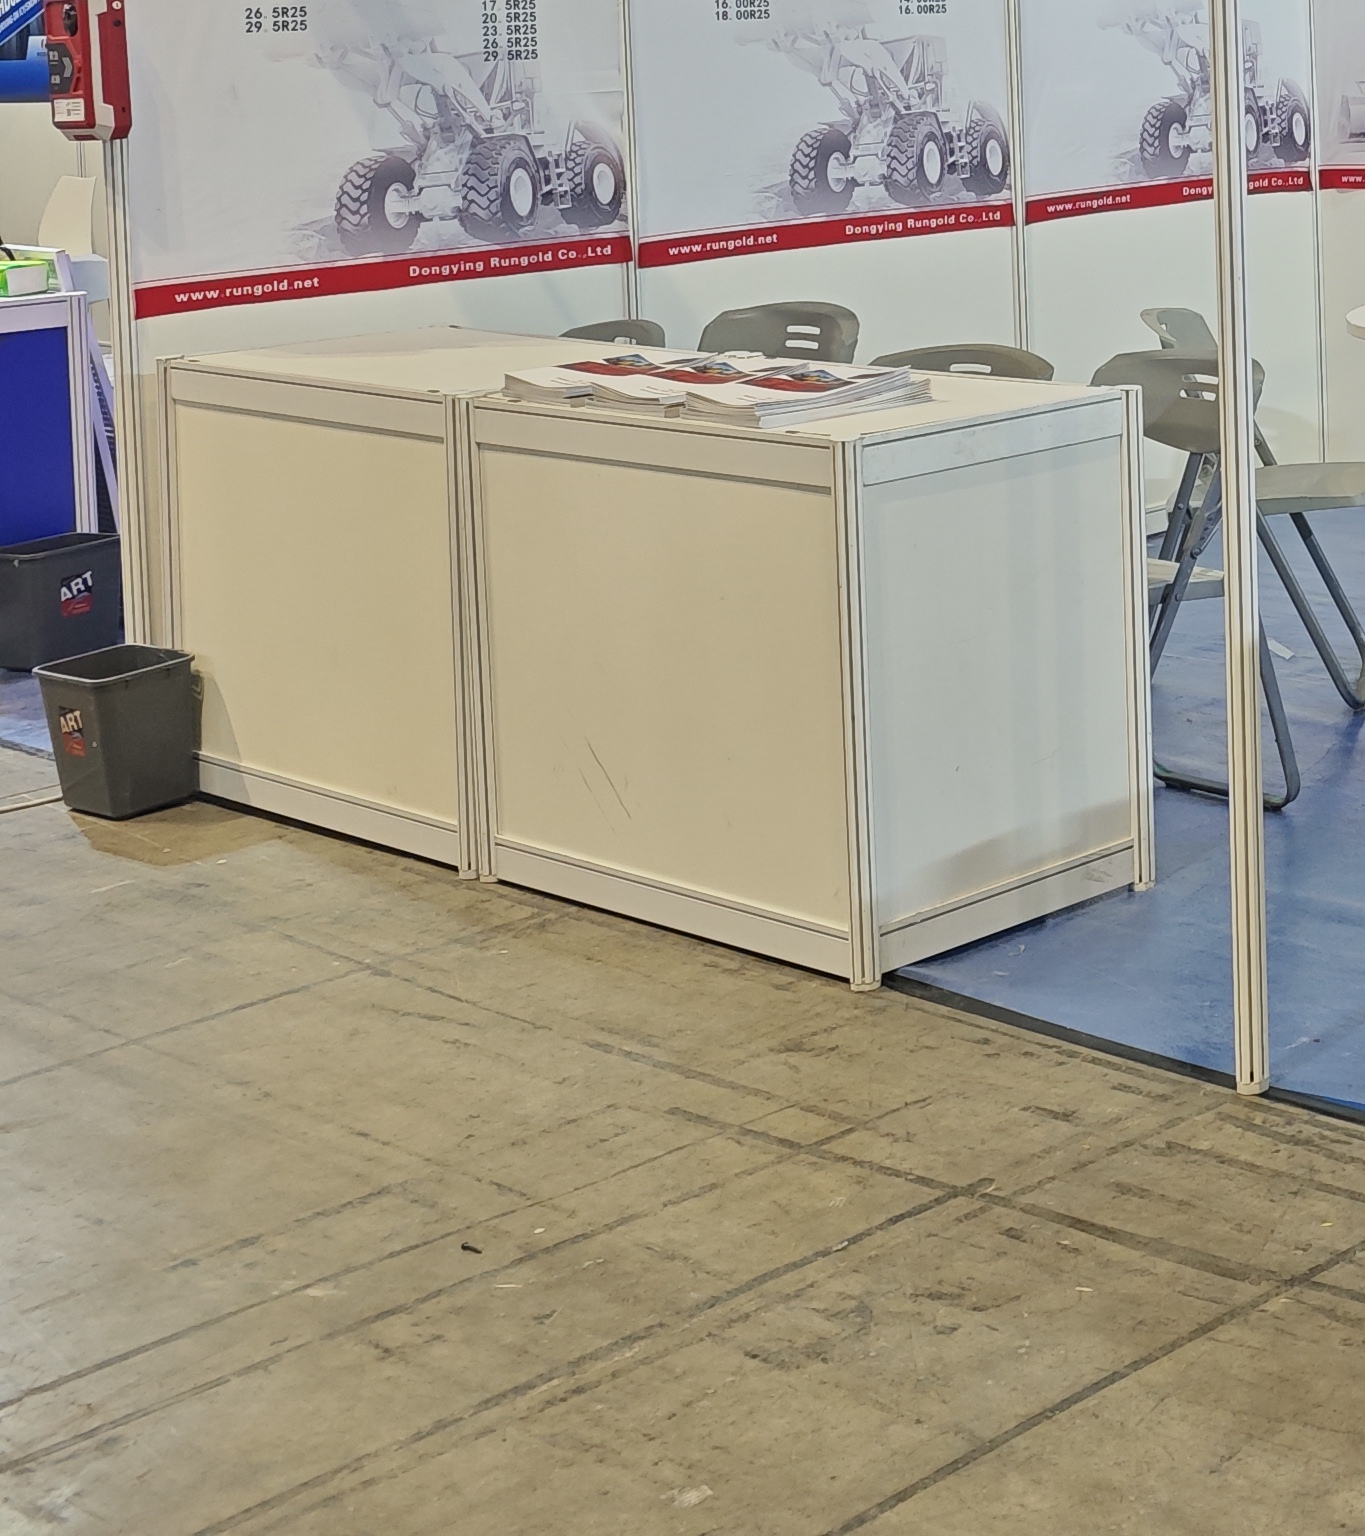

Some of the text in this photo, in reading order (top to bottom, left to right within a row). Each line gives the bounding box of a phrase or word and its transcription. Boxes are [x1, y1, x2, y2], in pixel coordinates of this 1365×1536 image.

[1047, 194, 1130, 212] www.rungold.net
[668, 233, 777, 256] www.rungold.net
[846, 221, 902, 235] Dongying
[907, 215, 955, 229] Rungold
[175, 277, 319, 303] www.rungold.net
[409, 259, 484, 277] Dongying
[490, 252, 552, 268] Rungold
[61, 570, 92, 602] ART
[60, 710, 82, 733] ART
